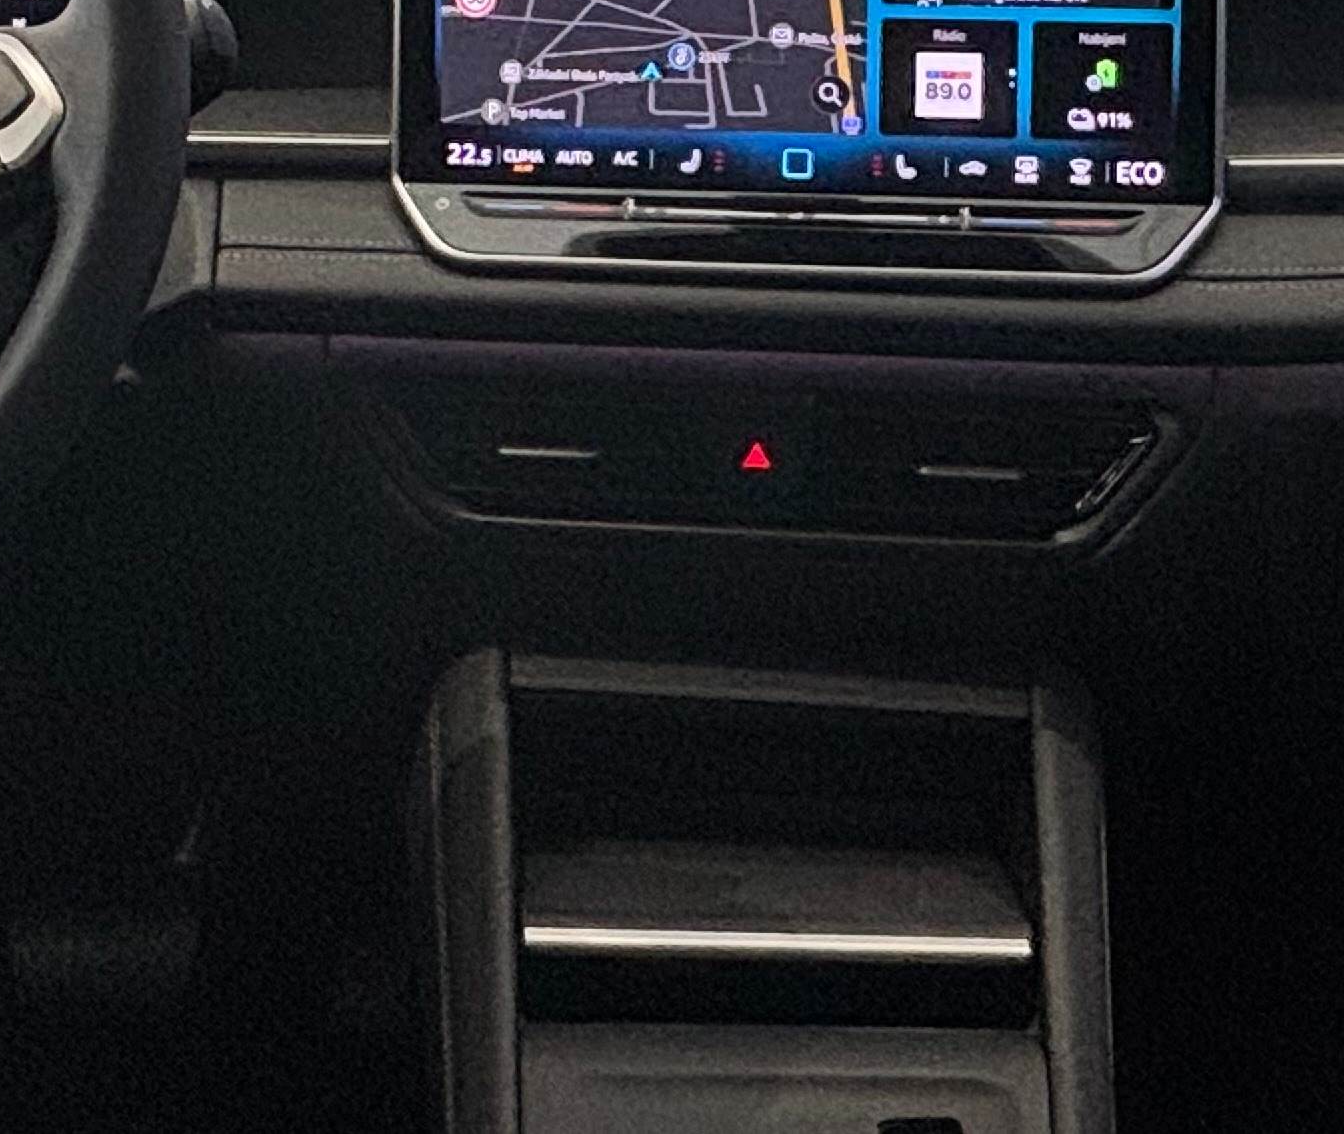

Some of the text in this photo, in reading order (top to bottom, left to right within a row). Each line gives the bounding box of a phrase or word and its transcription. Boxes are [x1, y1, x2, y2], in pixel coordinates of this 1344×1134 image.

[925, 83, 972, 100] 89.0
[447, 142, 493, 165] 22.5
[556, 150, 593, 165] AUTO
[1115, 160, 1165, 185] ECO
